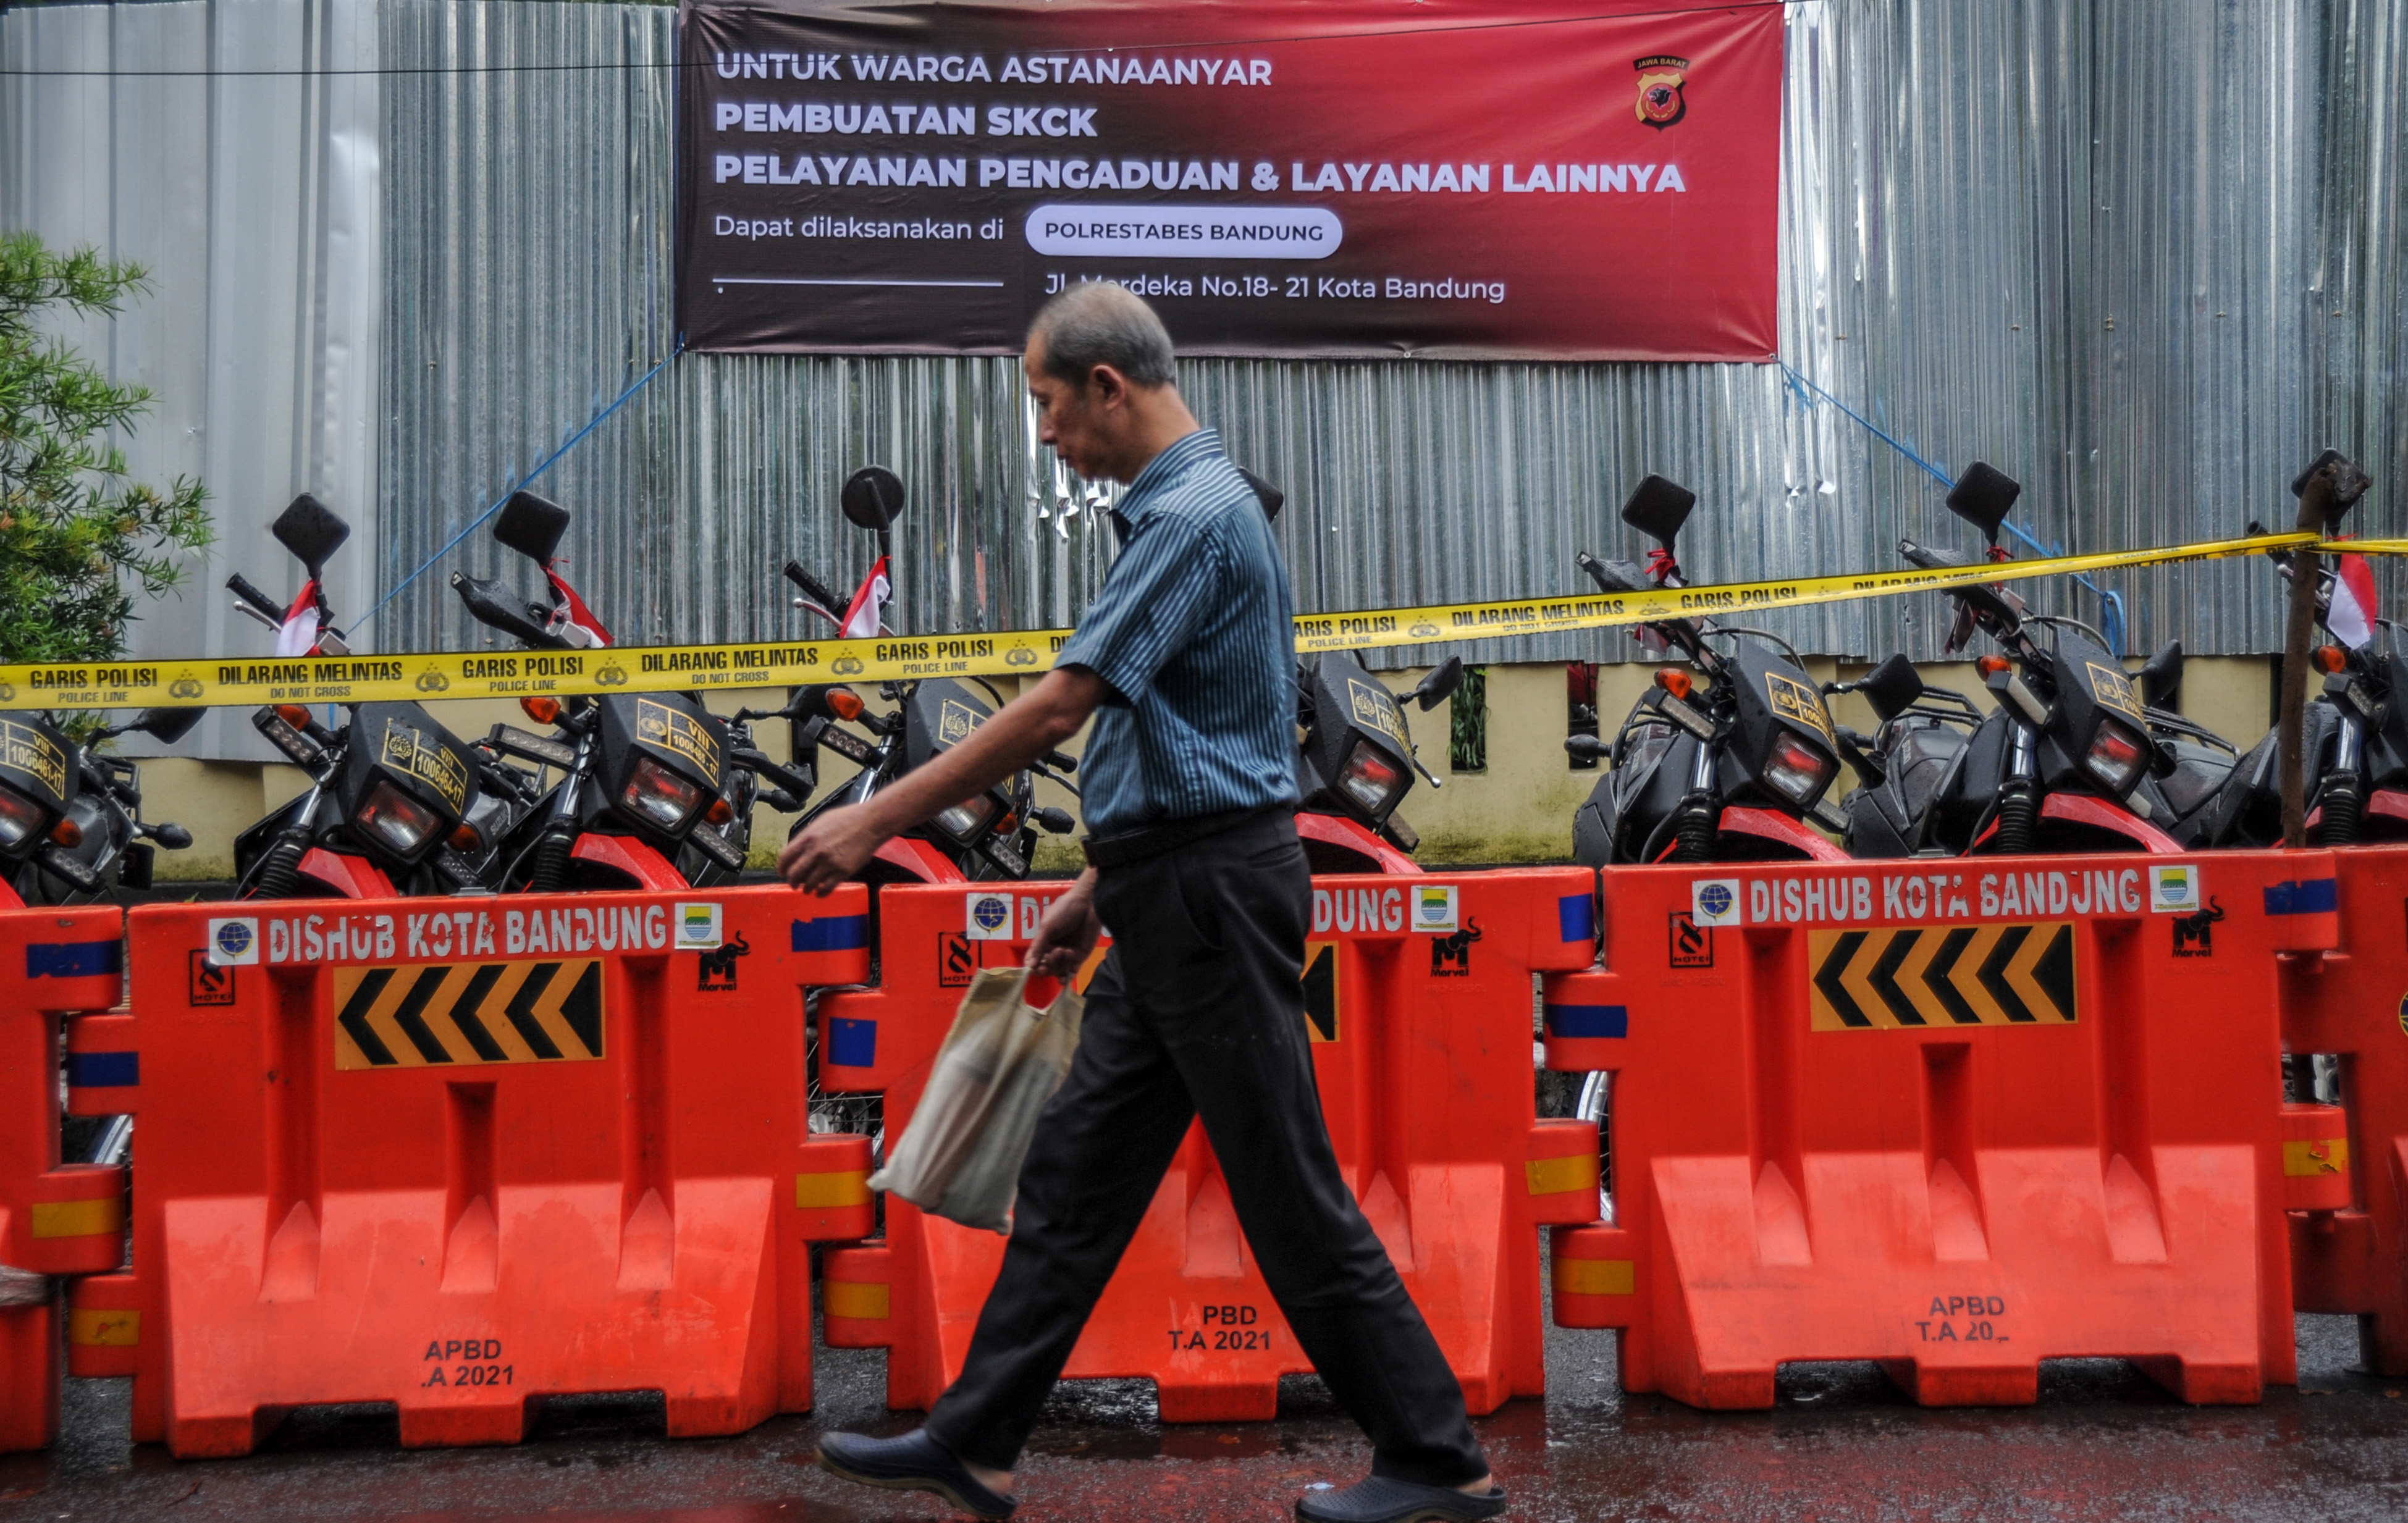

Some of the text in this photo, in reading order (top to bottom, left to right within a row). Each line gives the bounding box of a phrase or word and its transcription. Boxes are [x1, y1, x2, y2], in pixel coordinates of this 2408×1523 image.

[717, 53, 1272, 86] UNTUK WARGA ASTANAANYAR
[1637, 58, 1686, 69] JAWA BARAT
[716, 103, 1098, 136] PEMBUATAN SKCK
[716, 155, 1686, 193] PELAYANAN PENGADUAN & LAYANAN LAINNYA
[715, 216, 1004, 241] Dapat dilaksanakan di
[1045, 222, 1323, 243] POLRESTABES BANDUNG
[1286, 278, 1308, 298] 21
[1318, 278, 1376, 299] Kota
[1386, 278, 1505, 304] Bandung
[1681, 591, 1734, 609] GARIS
[1292, 599, 1625, 639] ARIS POLISI DILARANG MELINTAS
[876, 639, 994, 663] GARIS POLISI
[1308, 637, 1345, 648] POLICE
[1349, 636, 1373, 646] LINE
[462, 647, 819, 679] GARIS POLISI DILARANG MELINTAS
[903, 661, 968, 674] POLICE LINE
[30, 661, 403, 690] GARIS POLISI DILARANG MELINTAS
[489, 671, 769, 692] POLICE LINE DO NOT CROSS
[57, 685, 352, 703] POLICE LINE DO NOT CROSS
[33, 734, 49, 754] VIII
[688, 720, 710, 750] VIII
[1751, 877, 1872, 923] DISHUB
[1883, 875, 1969, 919] KOTA
[1313, 887, 1403, 933] DUNG
[269, 905, 667, 963] DISHUB KOTA BANDUNG
[2171, 947, 2212, 958] Marvel
[943, 975, 974, 983] HOTE
[1430, 968, 1469, 978] Marvel
[697, 982, 737, 992] Marvel
[1929, 1296, 2005, 1316] APBD
[1168, 1330, 1270, 1350] T.A 2021
[1914, 1321, 1958, 1341] T.A
[423, 1339, 502, 1361] APBD
[455, 1364, 513, 1387] 2021
